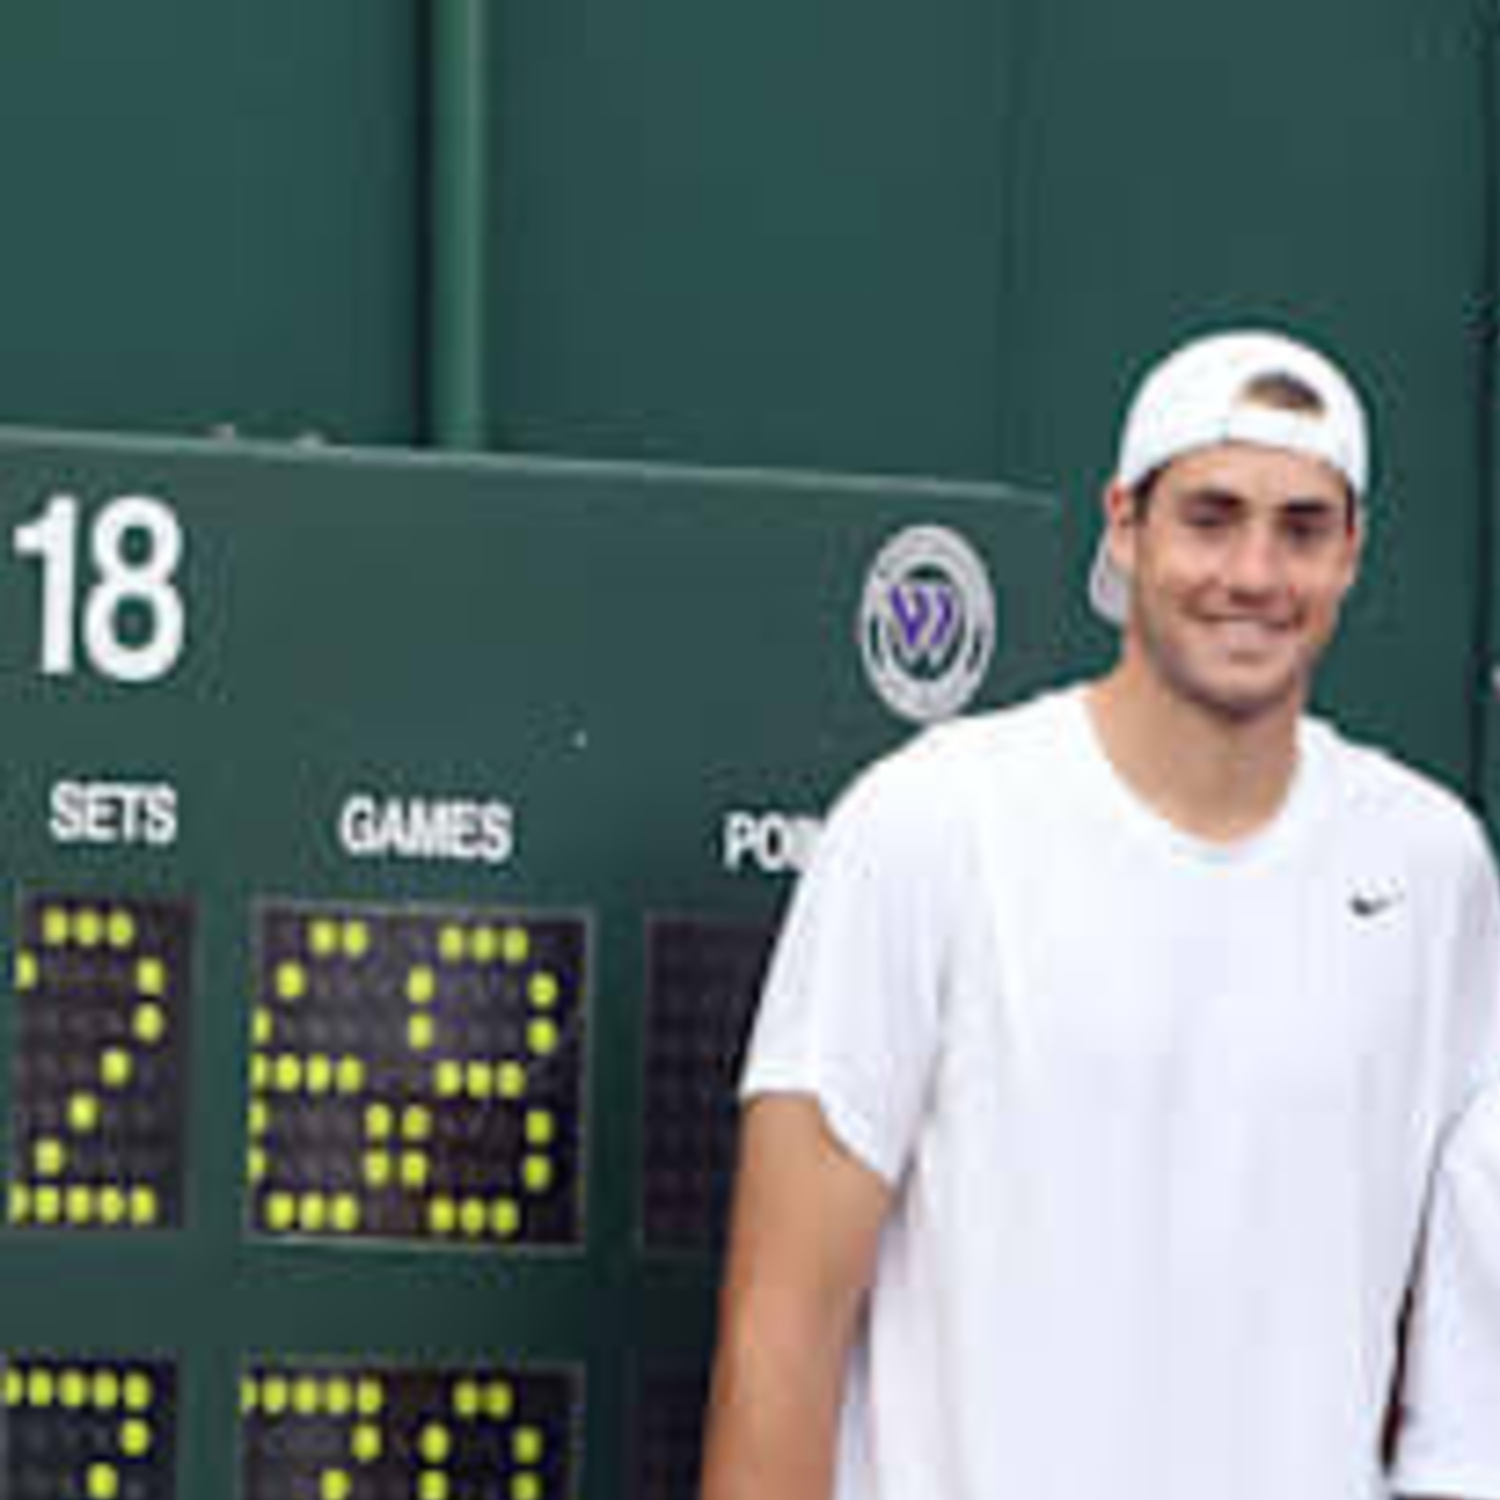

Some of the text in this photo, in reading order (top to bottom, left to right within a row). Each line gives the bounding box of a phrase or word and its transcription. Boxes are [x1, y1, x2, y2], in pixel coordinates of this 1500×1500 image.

[14, 495, 184, 681] 18
[49, 781, 177, 844] SETS
[339, 795, 513, 862] GAMES
[724, 811, 824, 870] POI
[9, 909, 164, 1224] 2
[247, 920, 557, 1233] 68
